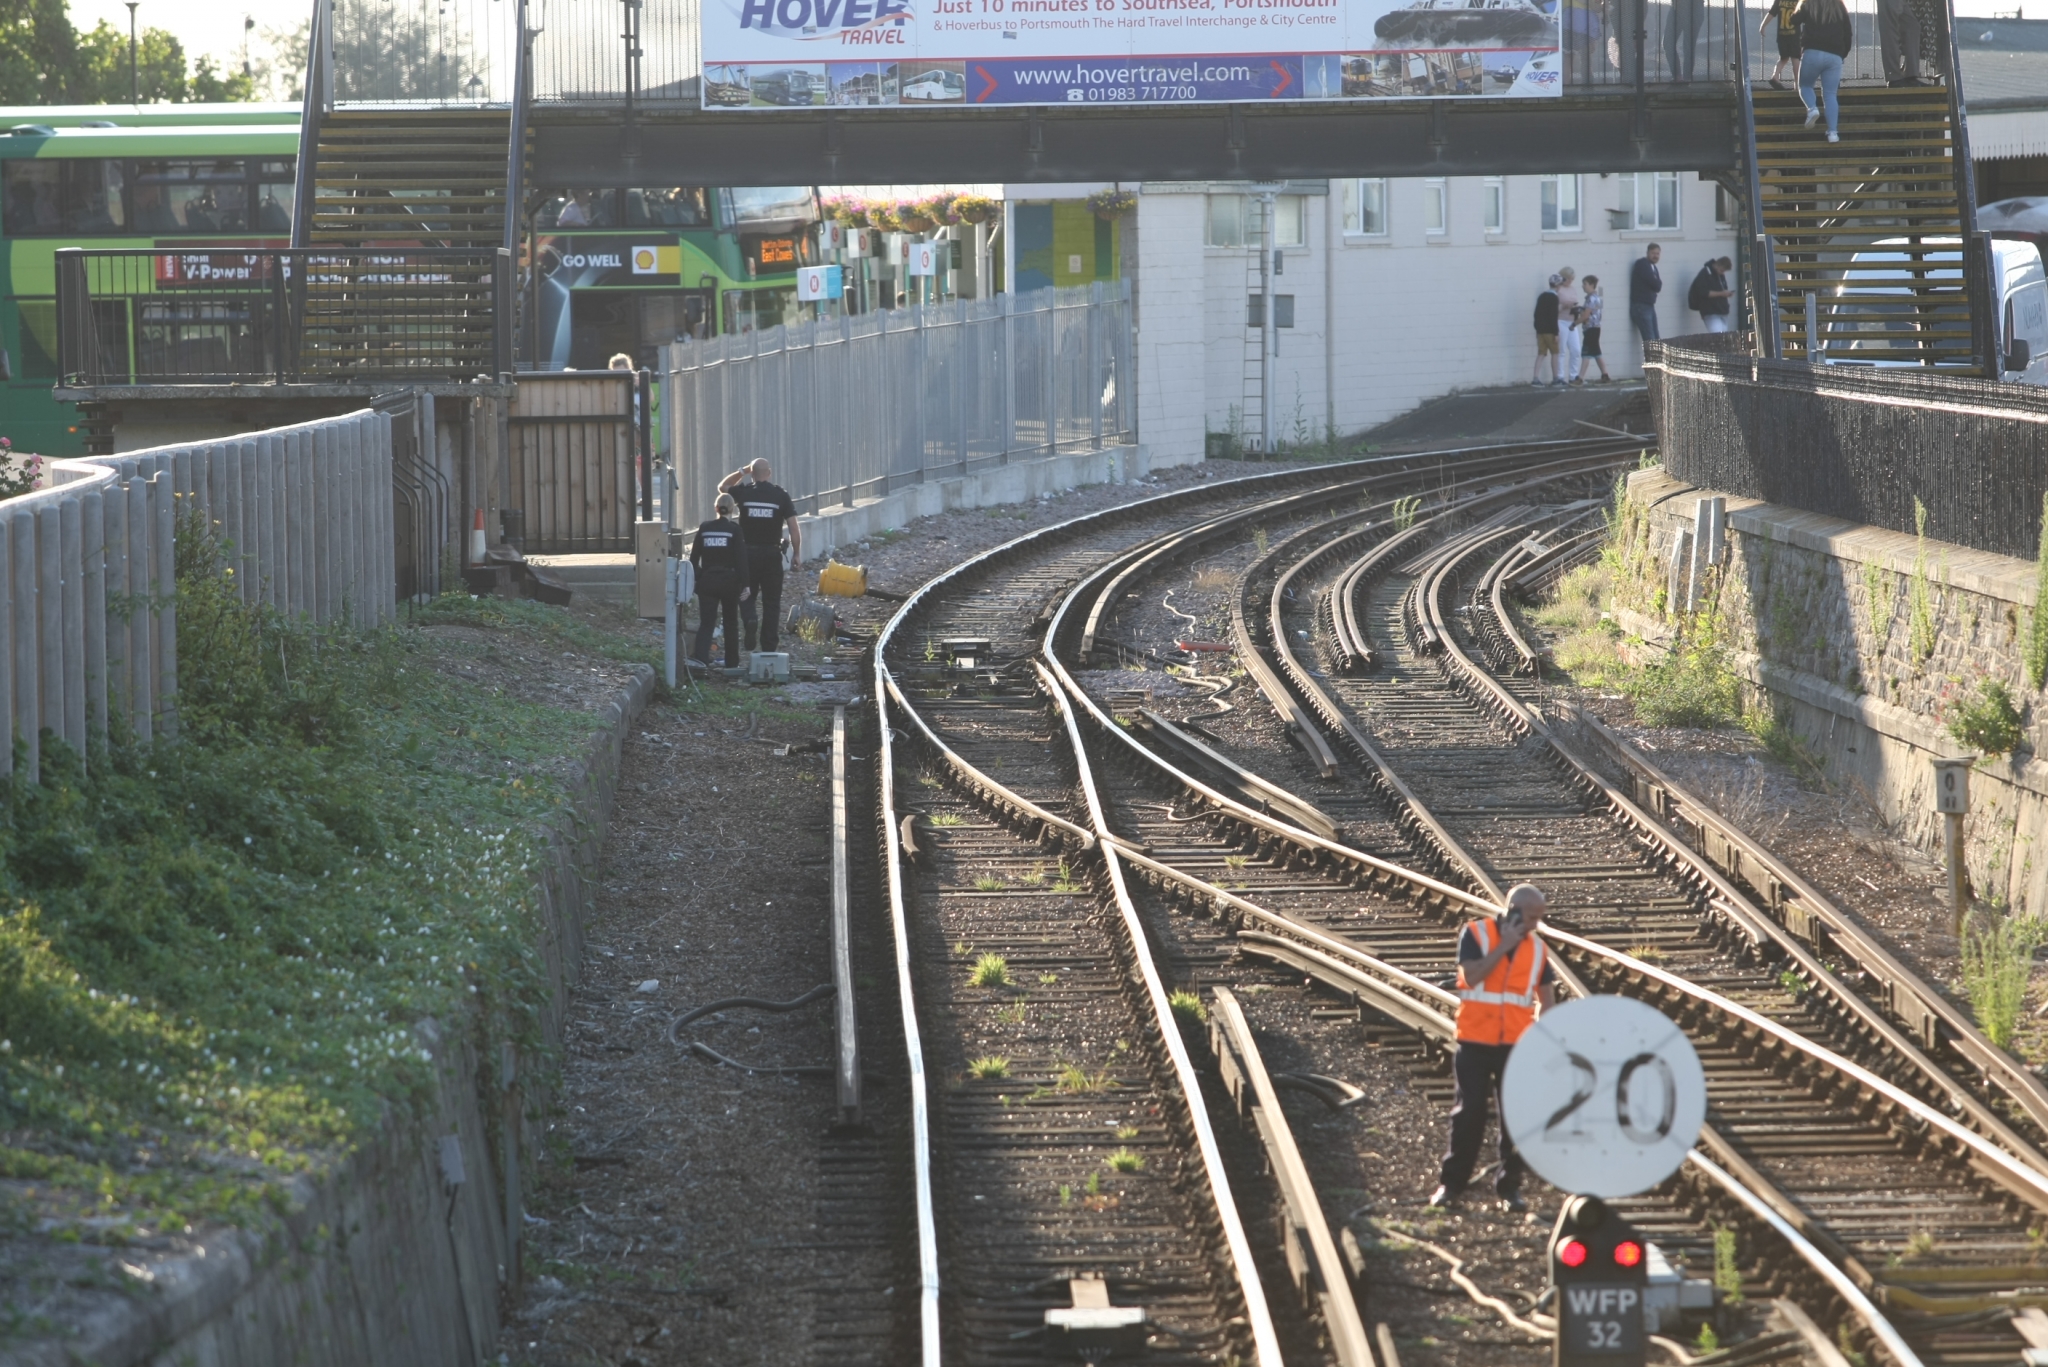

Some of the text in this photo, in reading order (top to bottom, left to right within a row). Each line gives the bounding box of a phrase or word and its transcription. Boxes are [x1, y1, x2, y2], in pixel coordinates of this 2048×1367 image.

[740, 0, 909, 29] HOVER
[933, 0, 973, 13] Just
[982, 0, 1004, 13] 10
[1011, 0, 1089, 12] minutes
[1095, 0, 1116, 12] to
[1122, 0, 1216, 11] Southsea,
[933, 14, 1337, 31] & Hoverbus to Portsmouth The Hard Travel Interchange & City Centre
[841, 29, 905, 45] TRAVEL
[1013, 62, 1250, 85] www.hovertravel.com
[1088, 86, 1197, 101] 01983 717700
[562, 254, 622, 268] GO WELL
[762, 249, 775, 263] East
[182, 264, 251, 280] V-Power
[748, 508, 774, 518] POLICE
[703, 537, 728, 547] POLICE
[1543, 1051, 1677, 1145] 20
[1567, 1288, 1638, 1315] WFP
[1587, 1320, 1622, 1349] 32
